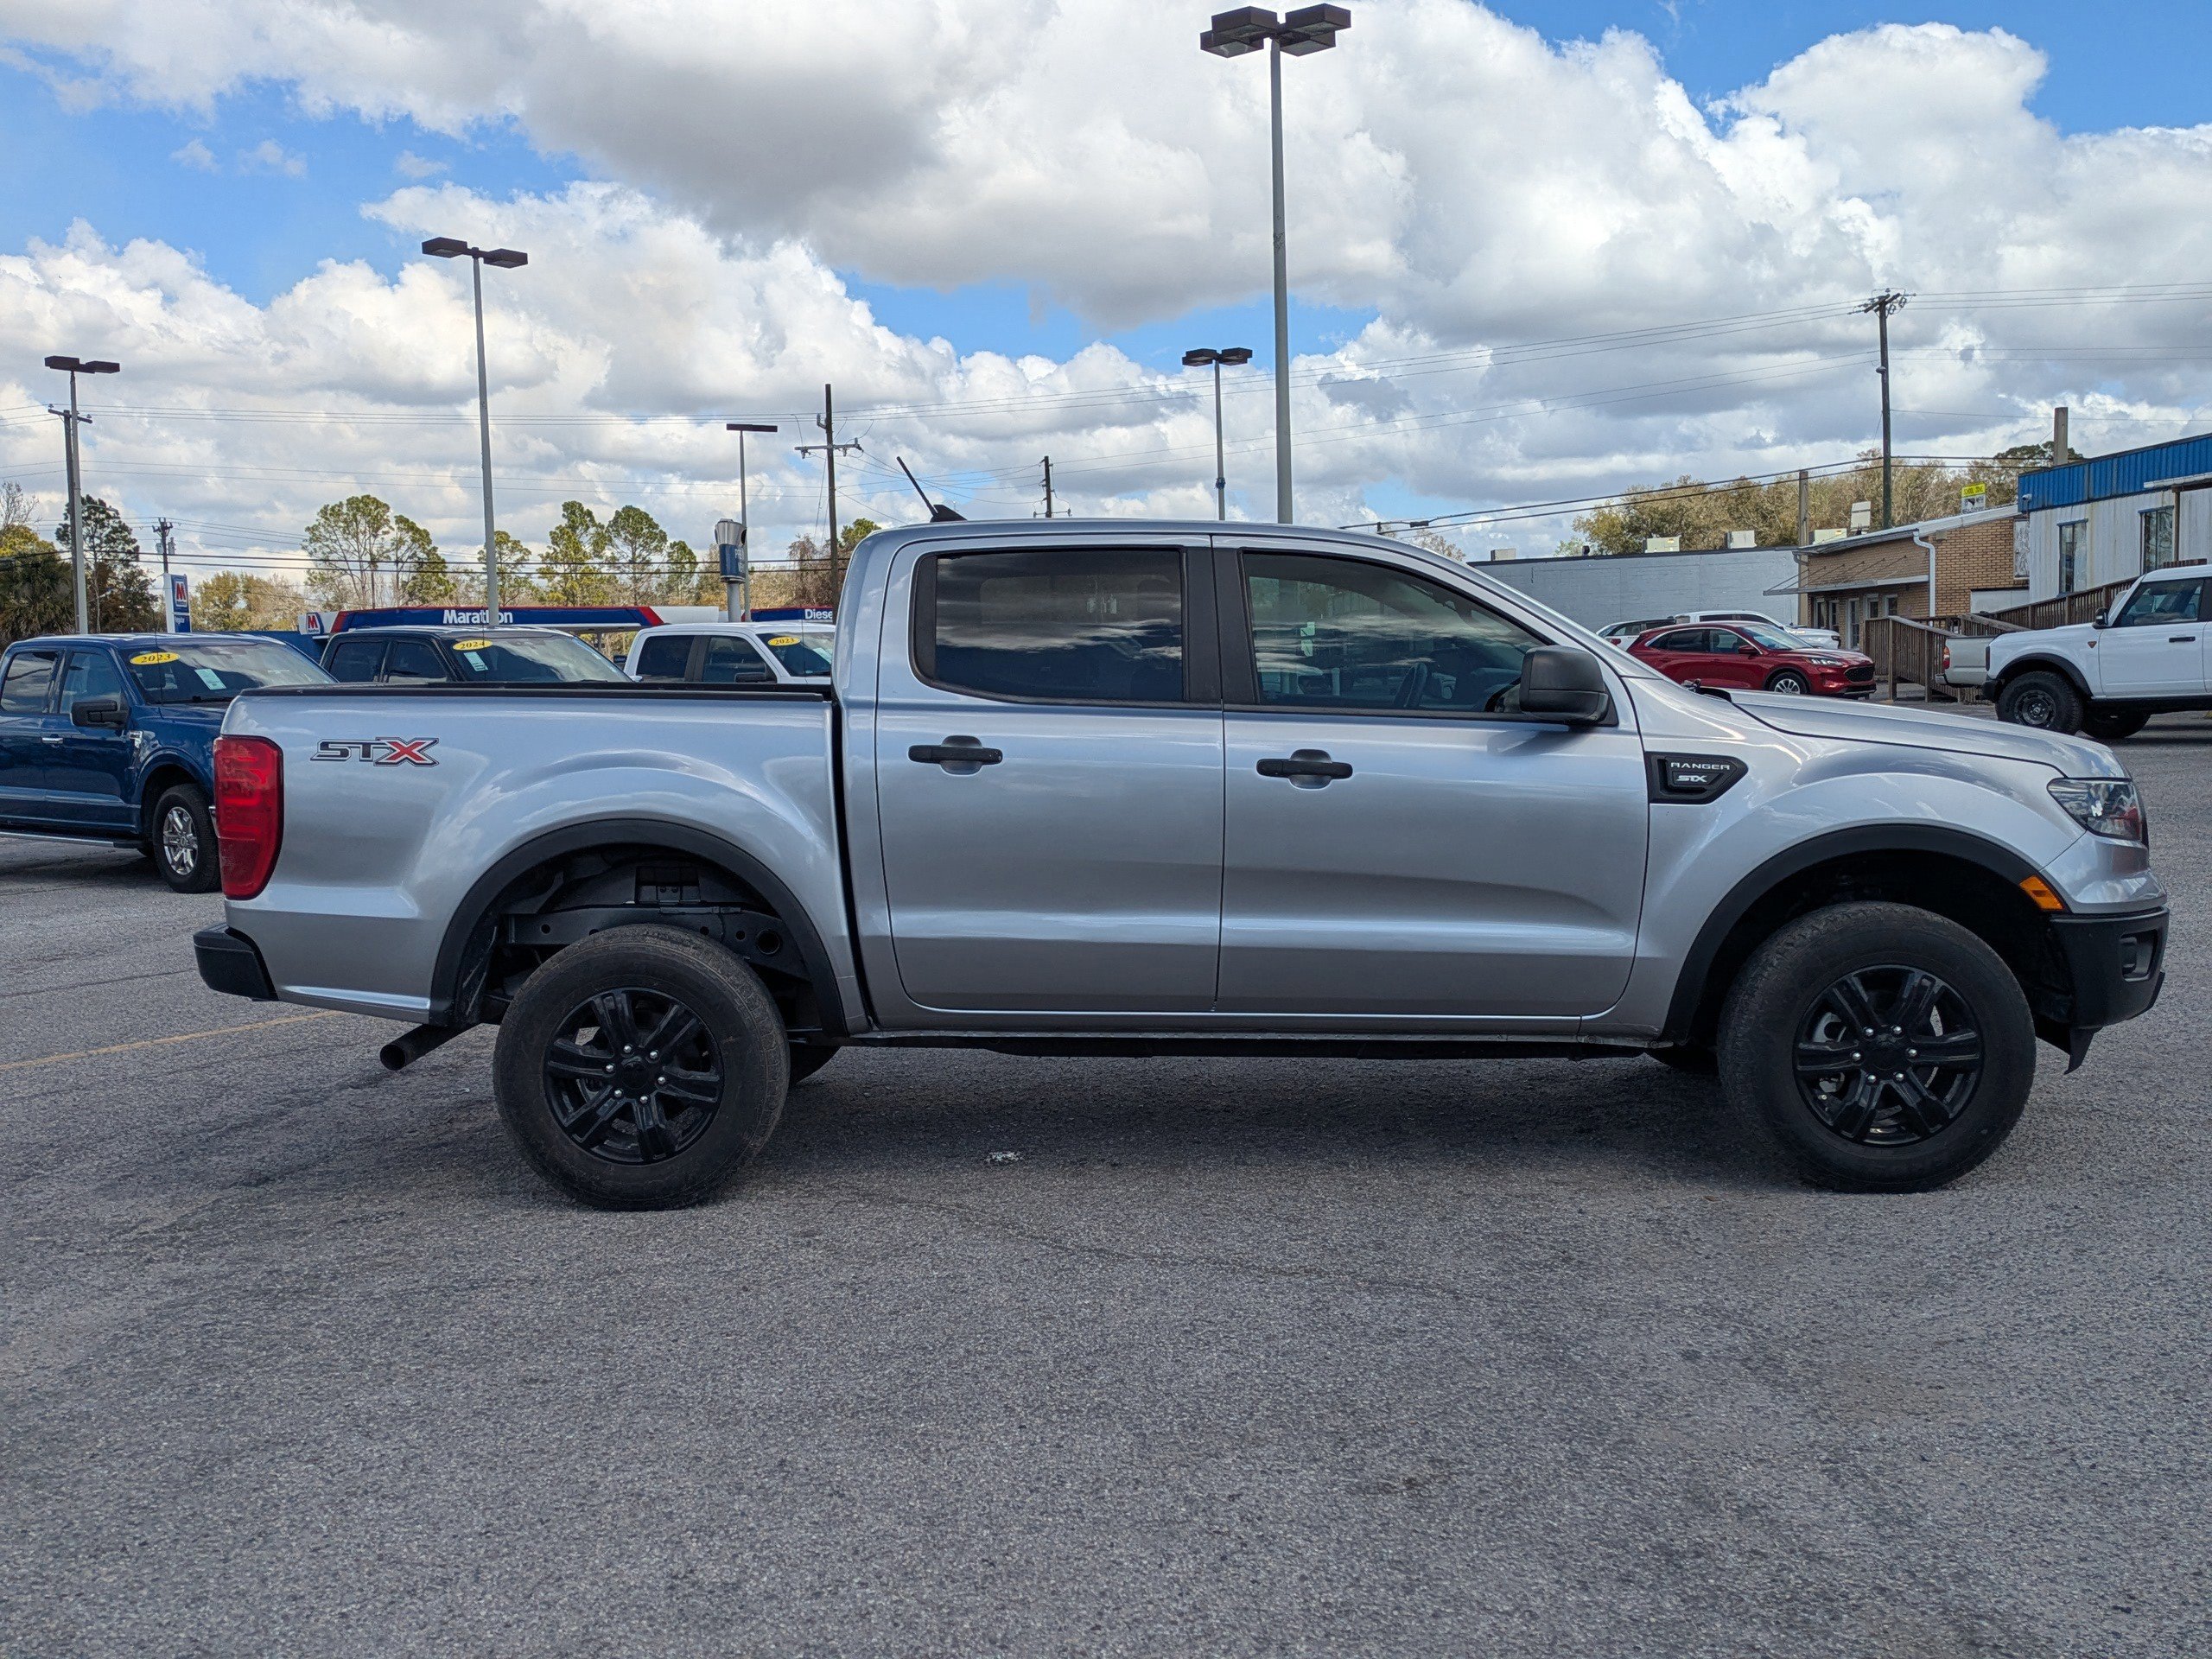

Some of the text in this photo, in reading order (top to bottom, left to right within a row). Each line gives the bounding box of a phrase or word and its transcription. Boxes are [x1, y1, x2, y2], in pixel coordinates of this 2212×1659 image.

[804, 608, 833, 620] Diese
[141, 653, 171, 664] 2023
[310, 736, 439, 767] STX
[1670, 762, 1731, 771] RANGER
